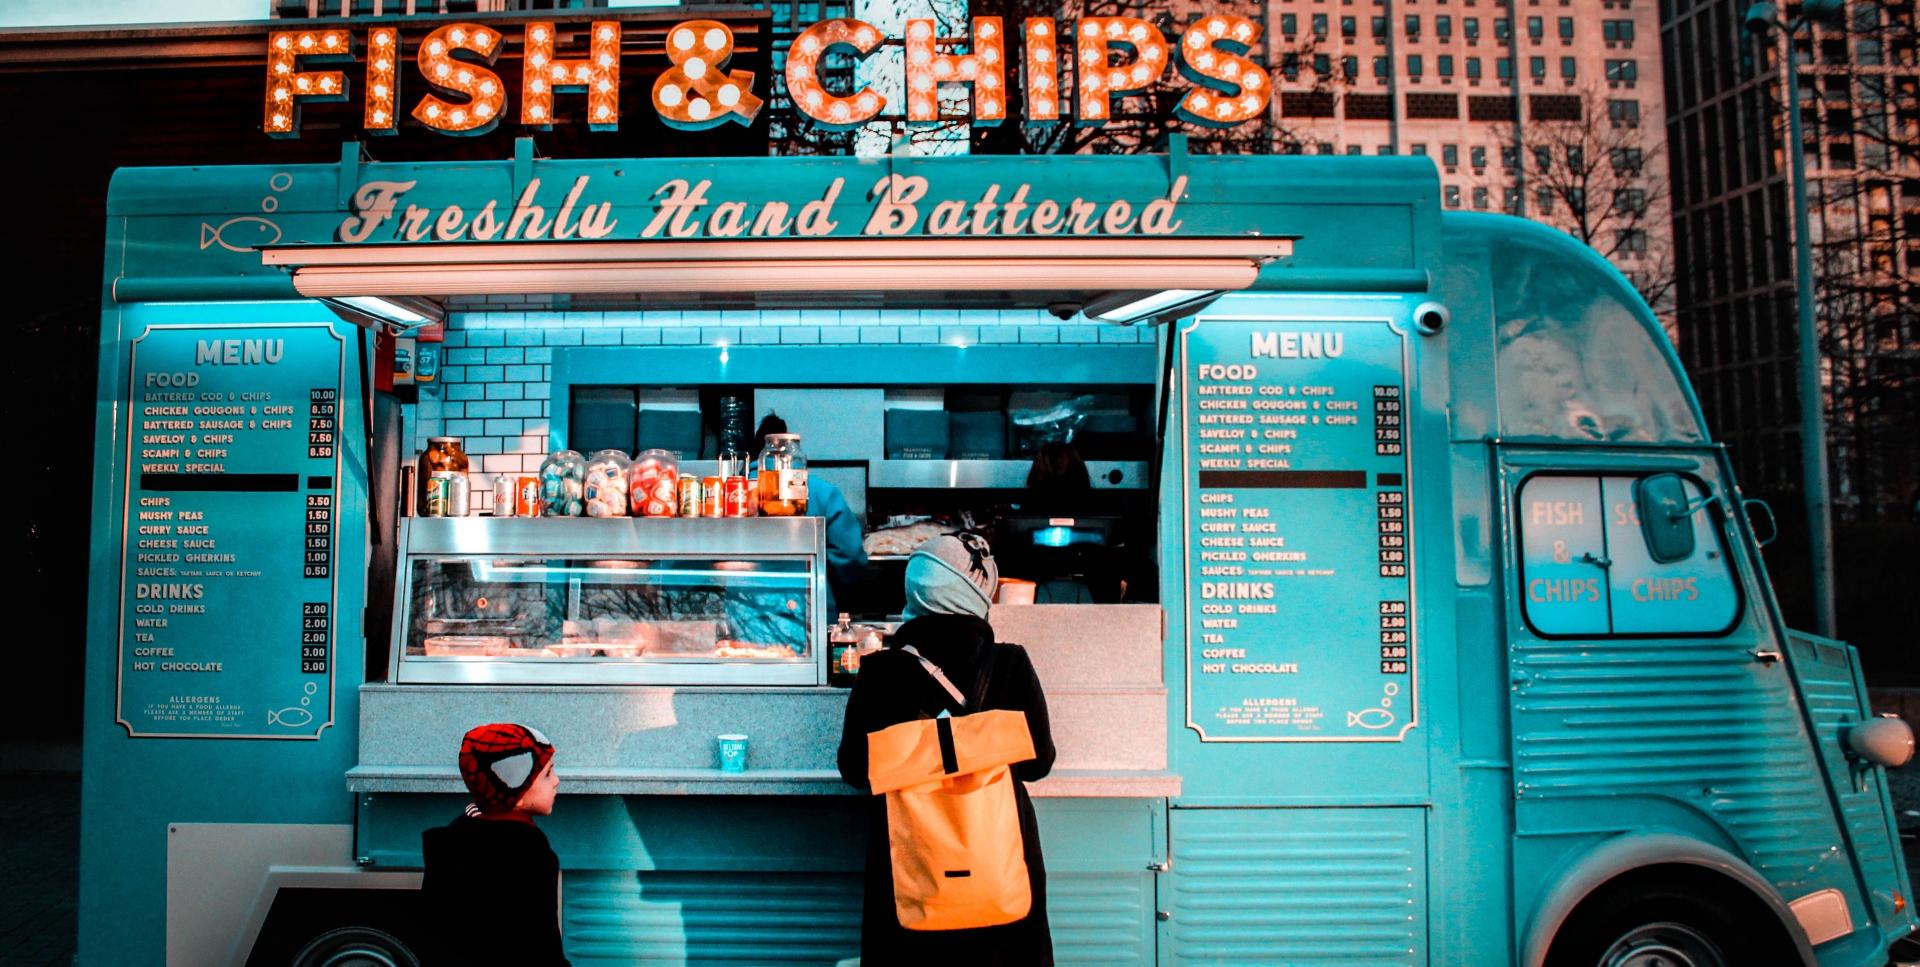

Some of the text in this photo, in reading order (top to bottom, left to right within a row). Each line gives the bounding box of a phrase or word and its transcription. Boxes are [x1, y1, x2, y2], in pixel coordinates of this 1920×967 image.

[264, 15, 1271, 136] FISH & CHIPS
[641, 177, 845, 240] Hand
[865, 174, 1188, 236] Battered
[1253, 332, 1343, 356] MENU
[198, 339, 283, 363] MENU
[1200, 365, 1257, 379] FOOD
[147, 372, 199, 386] FOOD
[1199, 386, 1253, 394] BATTERED
[1259, 386, 1283, 394] COD
[1375, 388, 1398, 396] 10.00
[146, 393, 194, 401] BATTERED
[229, 392, 234, 400] &
[242, 392, 271, 401] CHIPS
[312, 391, 334, 399] 10.00
[1200, 400, 1247, 409] CHICKEN
[1378, 402, 1399, 411] 8.50
[145, 407, 188, 415] CHICKEN
[264, 406, 293, 414] CHIPS
[1200, 415, 1253, 423] BATTERED
[1260, 415, 1306, 424] SAUSAGE
[1377, 416, 1399, 424] 7.50
[144, 421, 193, 429] BATTERED
[263, 420, 292, 428] CHIPS
[312, 420, 331, 428] 7.50
[144, 434, 331, 443] SAVELOY & CHIPS 7.50
[1200, 429, 1399, 439] SAVELOY & CHIPS 7.50
[143, 449, 179, 457] SCAMPI
[198, 449, 226, 457] CHIPS
[310, 448, 331, 456] 8.50
[1200, 444, 1400, 453] SCAMPI & CHIPS 8.50
[143, 464, 224, 472] WEEKLY SPECIAL
[1201, 459, 1289, 468] WEEKLY SPECIAL
[141, 497, 329, 506] CHIPS 3.50
[1201, 494, 1401, 502] CHIPS 3.50
[140, 511, 327, 520] MUSHY PEAS 1.50
[1201, 508, 1401, 517] MUSHY PEAS 1.50
[1532, 502, 1584, 525] FISH
[139, 525, 327, 534] CURRY SAUCE 1.50
[1202, 523, 1401, 532] CURRY SAUCE 1.50
[139, 539, 327, 548] CHEESE SAUCE 1.50
[1202, 537, 1402, 546] CHEESE SAUCE 1.50
[1202, 552, 1402, 561] PICKLED GHERKINS 1.00
[1553, 540, 1572, 564] &
[139, 553, 326, 562] PICKLED GHERKINS 1.00
[306, 567, 326, 575] 0.50
[1382, 566, 1404, 575] 0.50
[137, 584, 203, 598] DRINKS
[1203, 583, 1273, 598] DRINKS
[1529, 578, 1600, 603] CHIPS
[1631, 577, 1699, 601] CHIPS
[170, 605, 205, 613] DRINKS
[305, 605, 325, 613] 2.00
[1203, 604, 1404, 613] COLD DRINKS 2.00
[137, 619, 326, 627] WATER 2.00
[1203, 618, 1404, 628] WATER 2.00
[136, 633, 154, 641] TEA
[1203, 633, 1405, 643] TEA 2.00
[135, 648, 324, 656] COFFEE 3.00
[1203, 648, 1405, 658] COFFEE 3.00
[135, 662, 155, 670] HOT
[162, 662, 222, 671] CHOCOLATE
[1203, 663, 1405, 672] HOT CHOCOLATE 3.00
